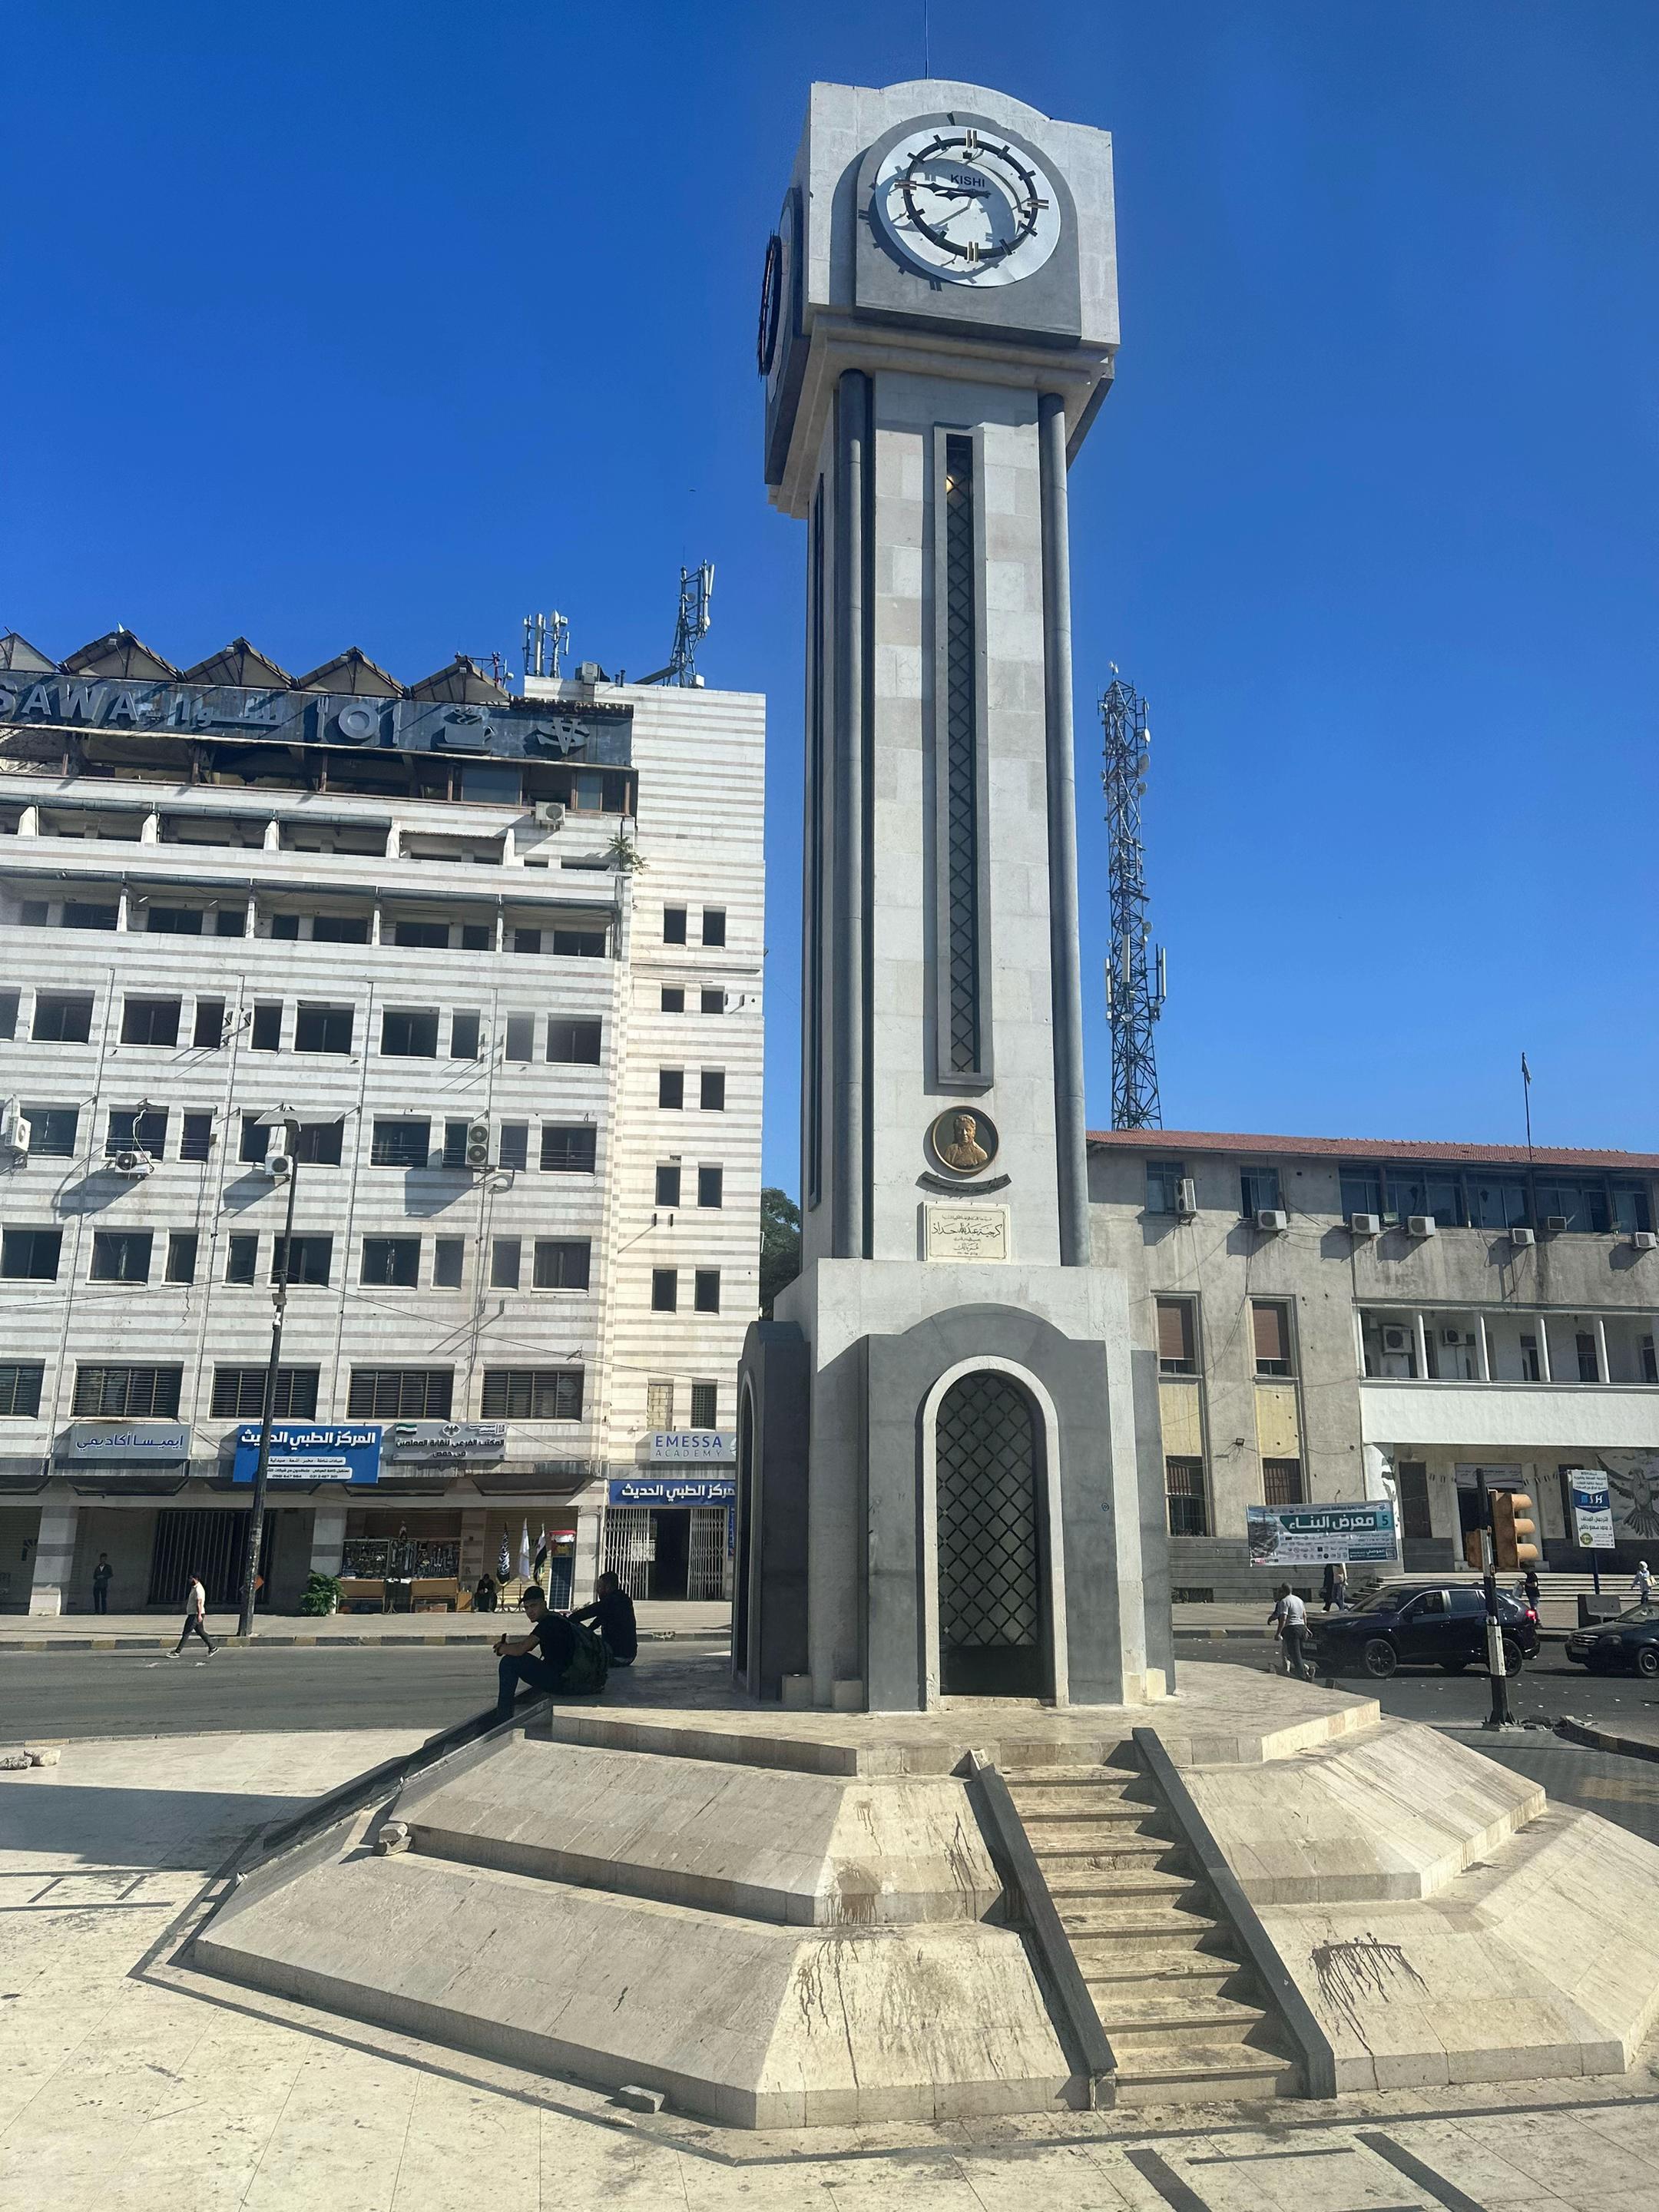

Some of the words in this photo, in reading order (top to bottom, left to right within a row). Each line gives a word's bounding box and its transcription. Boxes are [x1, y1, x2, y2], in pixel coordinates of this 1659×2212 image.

[951, 174, 985, 188] KISHI
[75, 1432, 131, 1452] أكاديمي
[132, 1434, 184, 1450] إيميسا
[241, 1429, 288, 1447] الحيث
[290, 1432, 333, 1450] الطبي
[335, 1431, 376, 1447] المركز
[396, 1439, 428, 1448] المعلمين
[430, 1438, 450, 1446] لنقابة
[655, 1435, 722, 1448] EMESSA
[621, 1483, 664, 1498] الحديث
[666, 1485, 705, 1501] الطبي
[707, 1484, 735, 1498] مركز
[1289, 1515, 1330, 1532] البناء
[1332, 1514, 1375, 1531] معرض
[1382, 1515, 1389, 1526] 5
